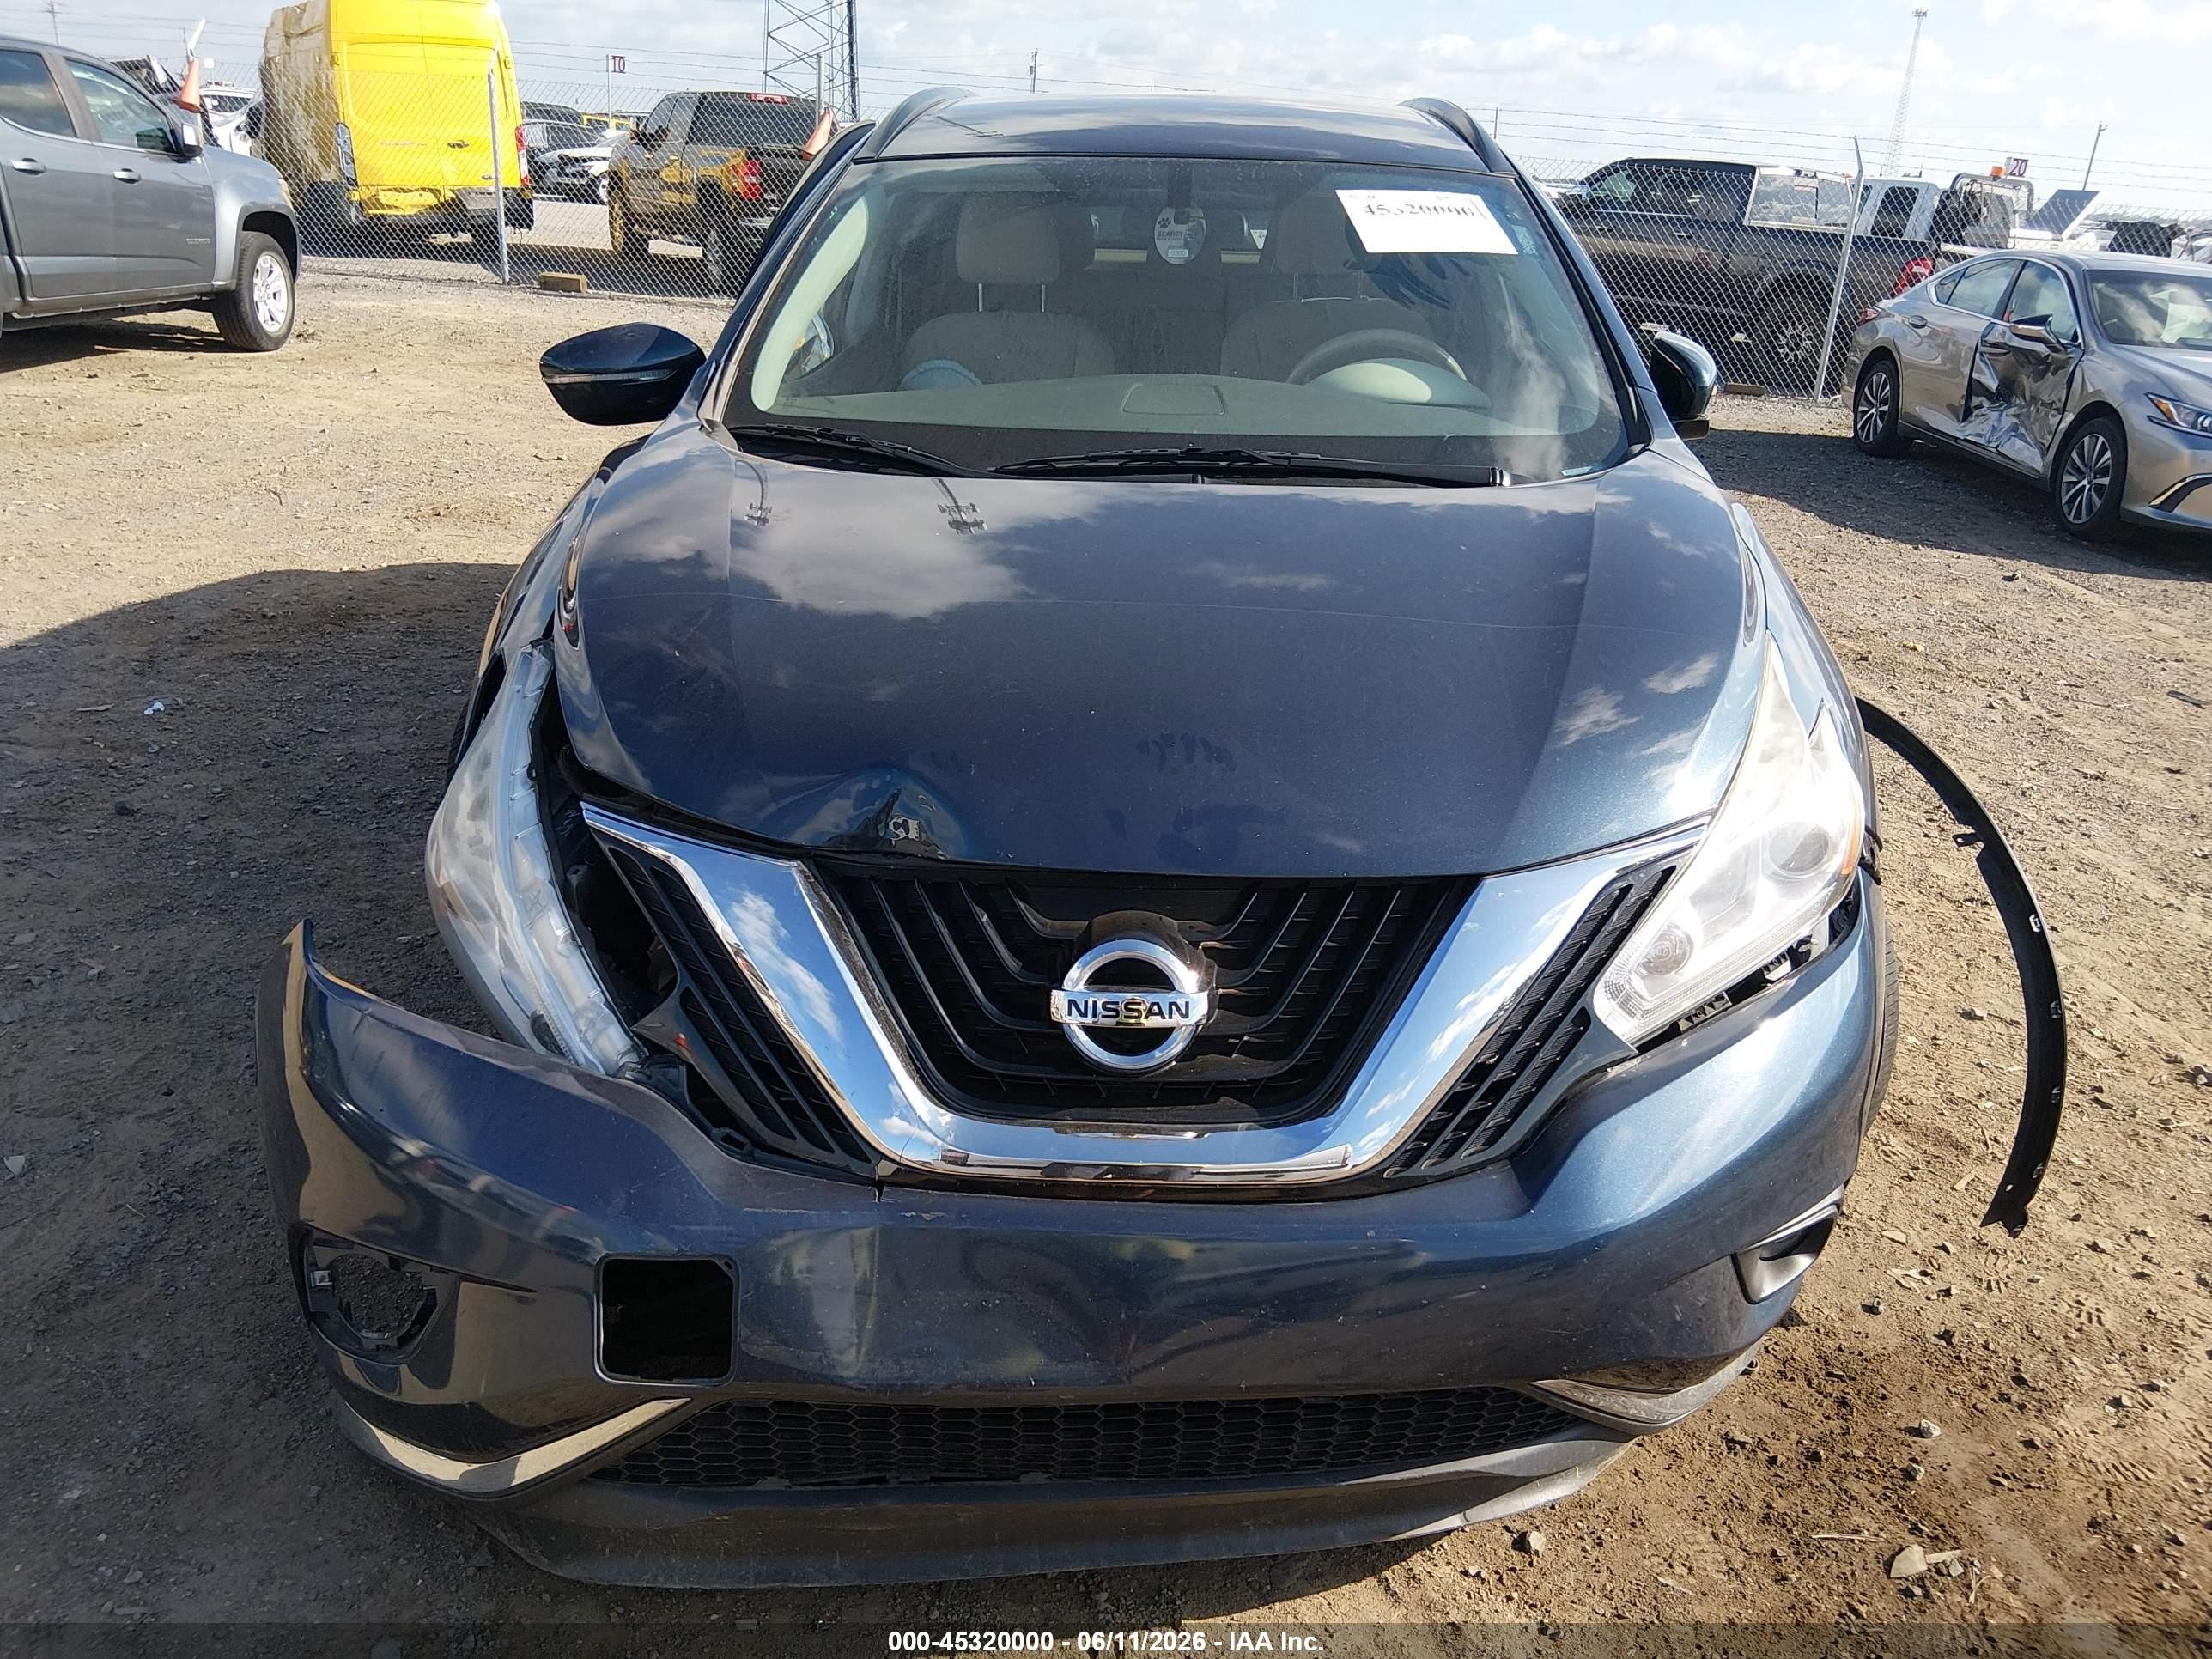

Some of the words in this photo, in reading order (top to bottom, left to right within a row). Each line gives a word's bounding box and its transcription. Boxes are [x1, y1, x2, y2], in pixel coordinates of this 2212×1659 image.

[611, 55, 626, 74] 10
[2009, 158, 2029, 178] 20
[1067, 999, 1189, 1019] NISSAN
